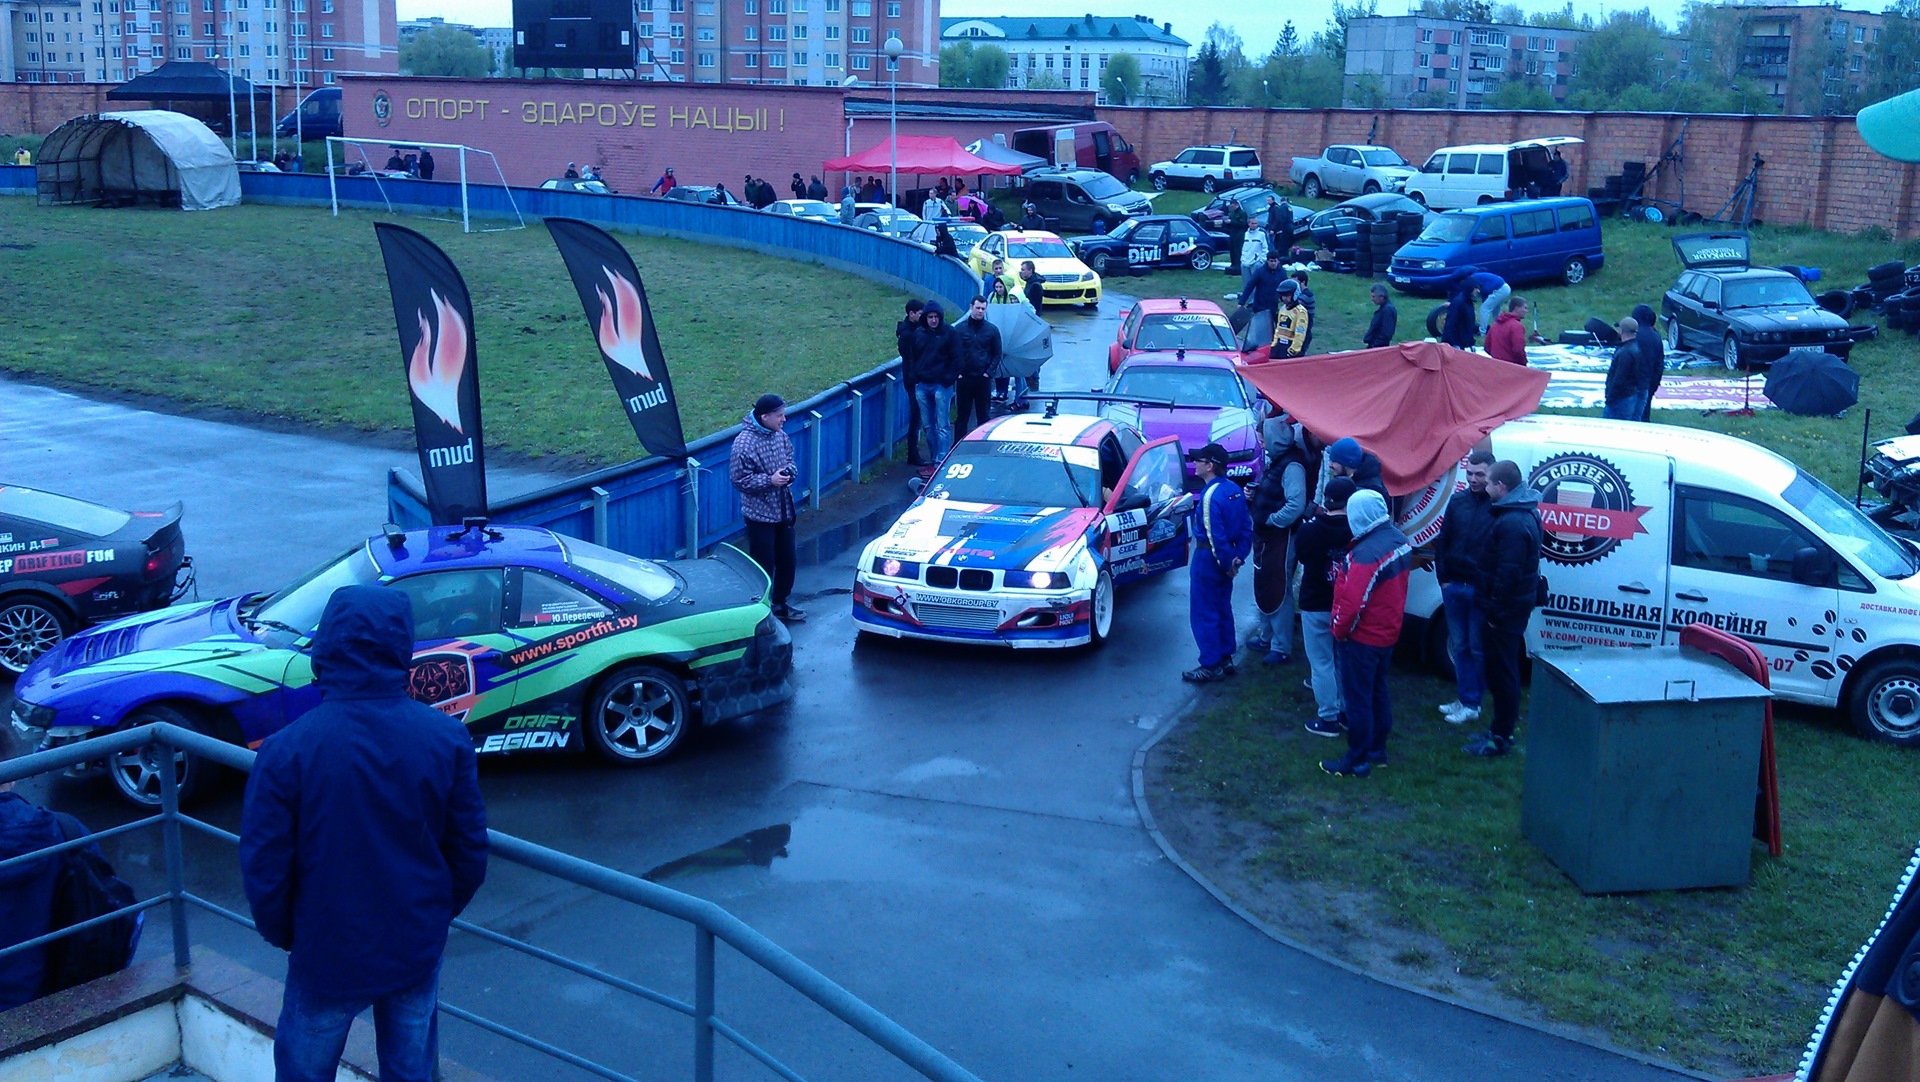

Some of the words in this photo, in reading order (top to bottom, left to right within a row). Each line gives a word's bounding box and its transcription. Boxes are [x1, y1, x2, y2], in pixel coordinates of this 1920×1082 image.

[406, 98, 490, 120] СПОРТ
[521, 101, 656, 127] ЗДАРОЎЕ
[945, 463, 974, 479] 99
[1549, 463, 1606, 483] COFFEE
[1116, 511, 1136, 526] IBA
[1121, 530, 1139, 544] burn
[0, 543, 26, 553] КИН
[18, 553, 82, 570] DRIFTING
[87, 549, 115, 563] FUN
[1860, 603, 1897, 613] ДОСТАВКА
[1898, 607, 1918, 616] КОФЕ
[1671, 608, 1768, 636] КОФЕЙНЯ
[510, 614, 638, 665] www.sportfit.by
[503, 714, 577, 730] DRIFT
[475, 731, 570, 753] EGION
